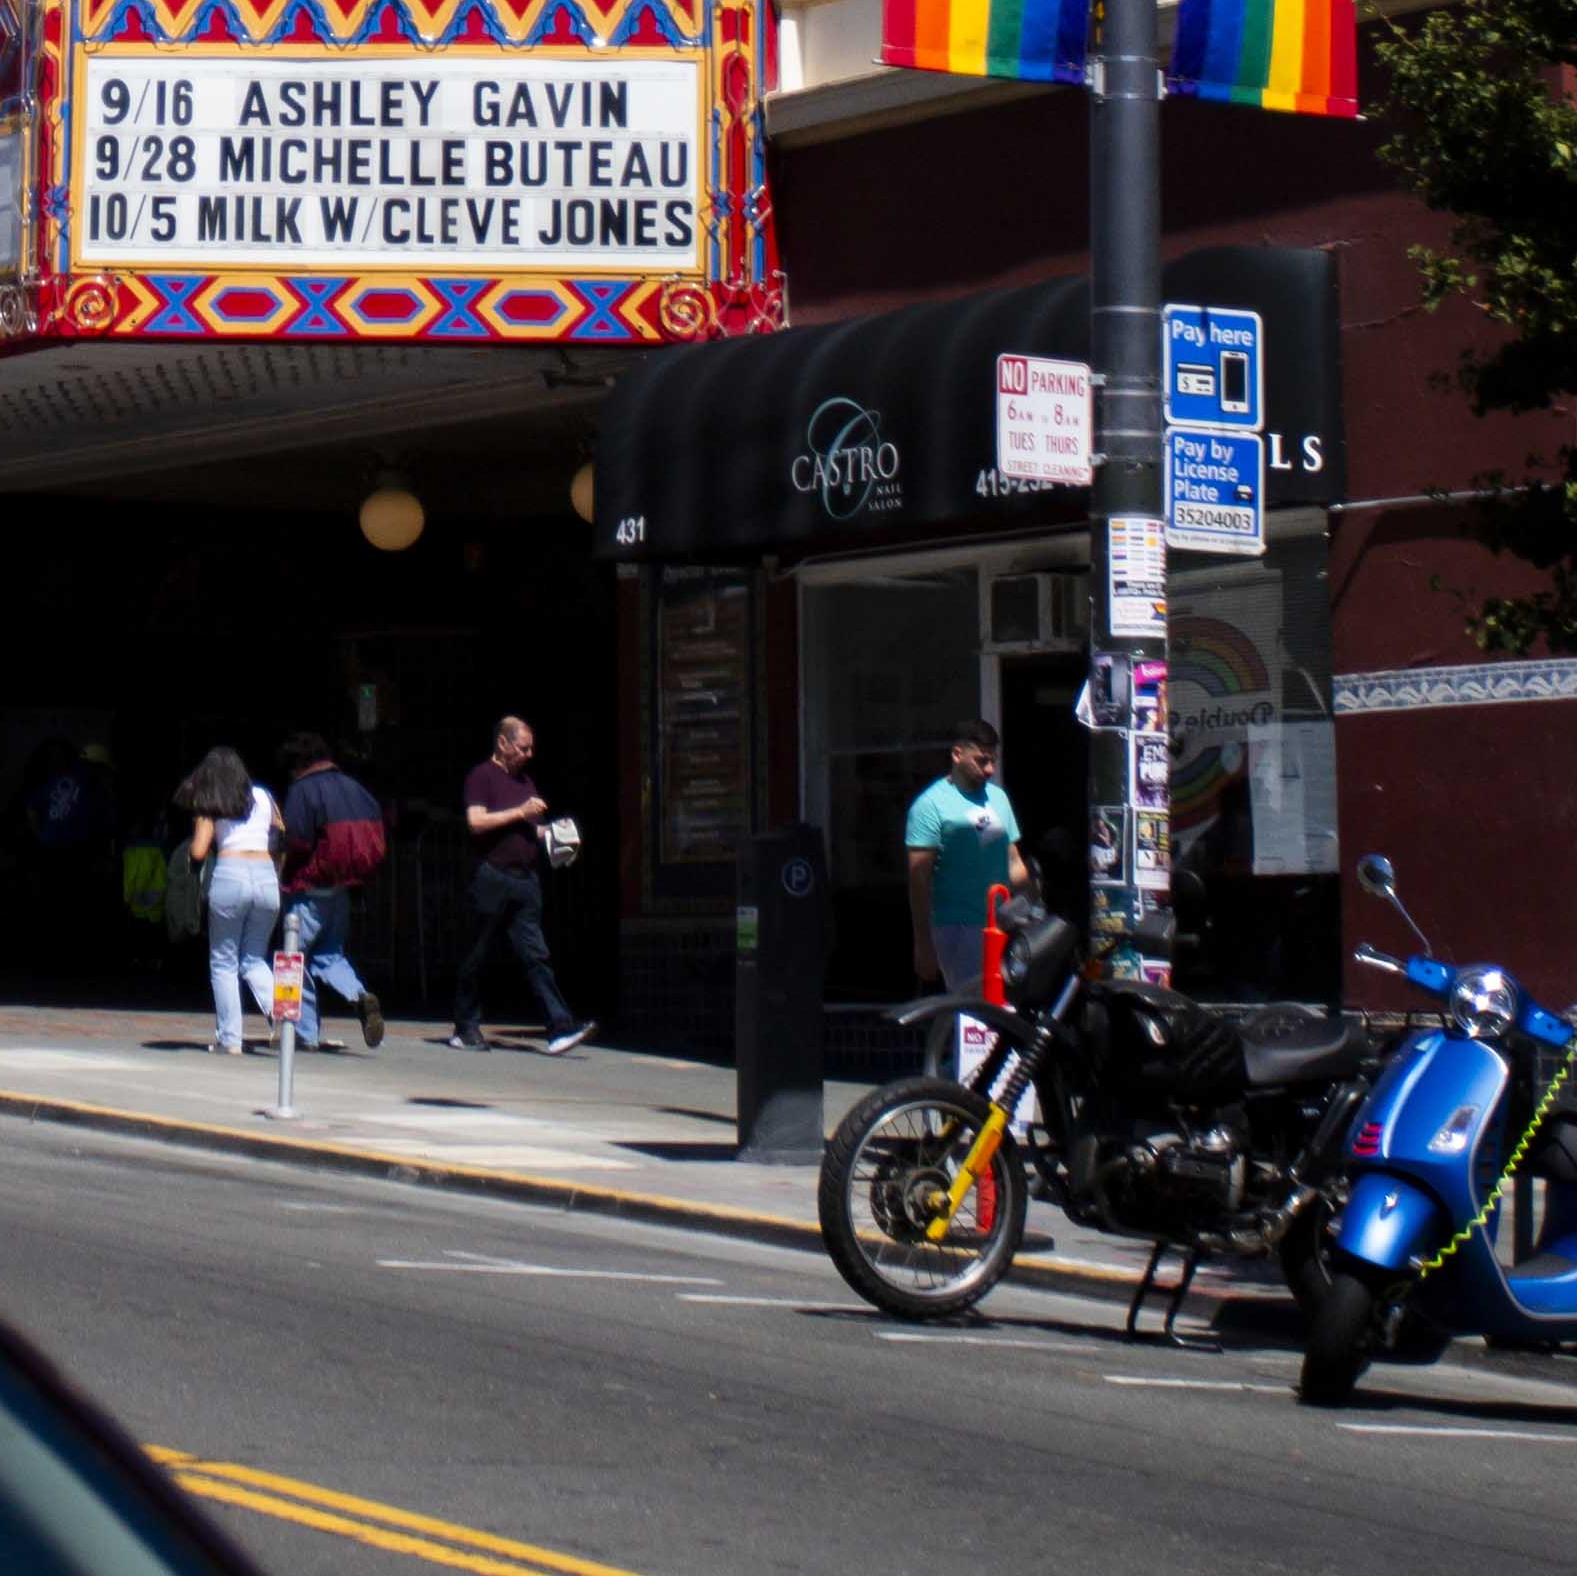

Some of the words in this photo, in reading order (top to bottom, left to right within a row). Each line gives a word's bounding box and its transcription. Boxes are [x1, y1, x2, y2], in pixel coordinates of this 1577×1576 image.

[100, 78, 195, 127] 9/16
[238, 79, 440, 127] ASHLEY
[472, 79, 629, 128] GAVIN
[94, 133, 197, 183] 9/28
[219, 136, 465, 186] MICHELLE
[484, 138, 689, 188] BUTEAU
[89, 193, 177, 243] 10/5
[197, 195, 300, 244] MILK
[320, 196, 521, 246] W/CLEVE
[538, 199, 693, 247] JONES
[1172, 318, 1205, 348] Pay
[1209, 322, 1253, 347] here
[1001, 359, 1026, 392] NO
[1031, 370, 1085, 397] PARKING
[1008, 431, 1035, 451] TUES
[1045, 434, 1079, 456] THURS
[1174, 436, 1205, 463] Pay
[1211, 438, 1235, 464] by
[791, 441, 900, 493] CASTRO
[1174, 458, 1239, 484] License
[867, 498, 903, 511] SALON
[1174, 478, 1219, 503] Plate
[615, 514, 646, 545] 431
[1175, 507, 1252, 530] 35204003
